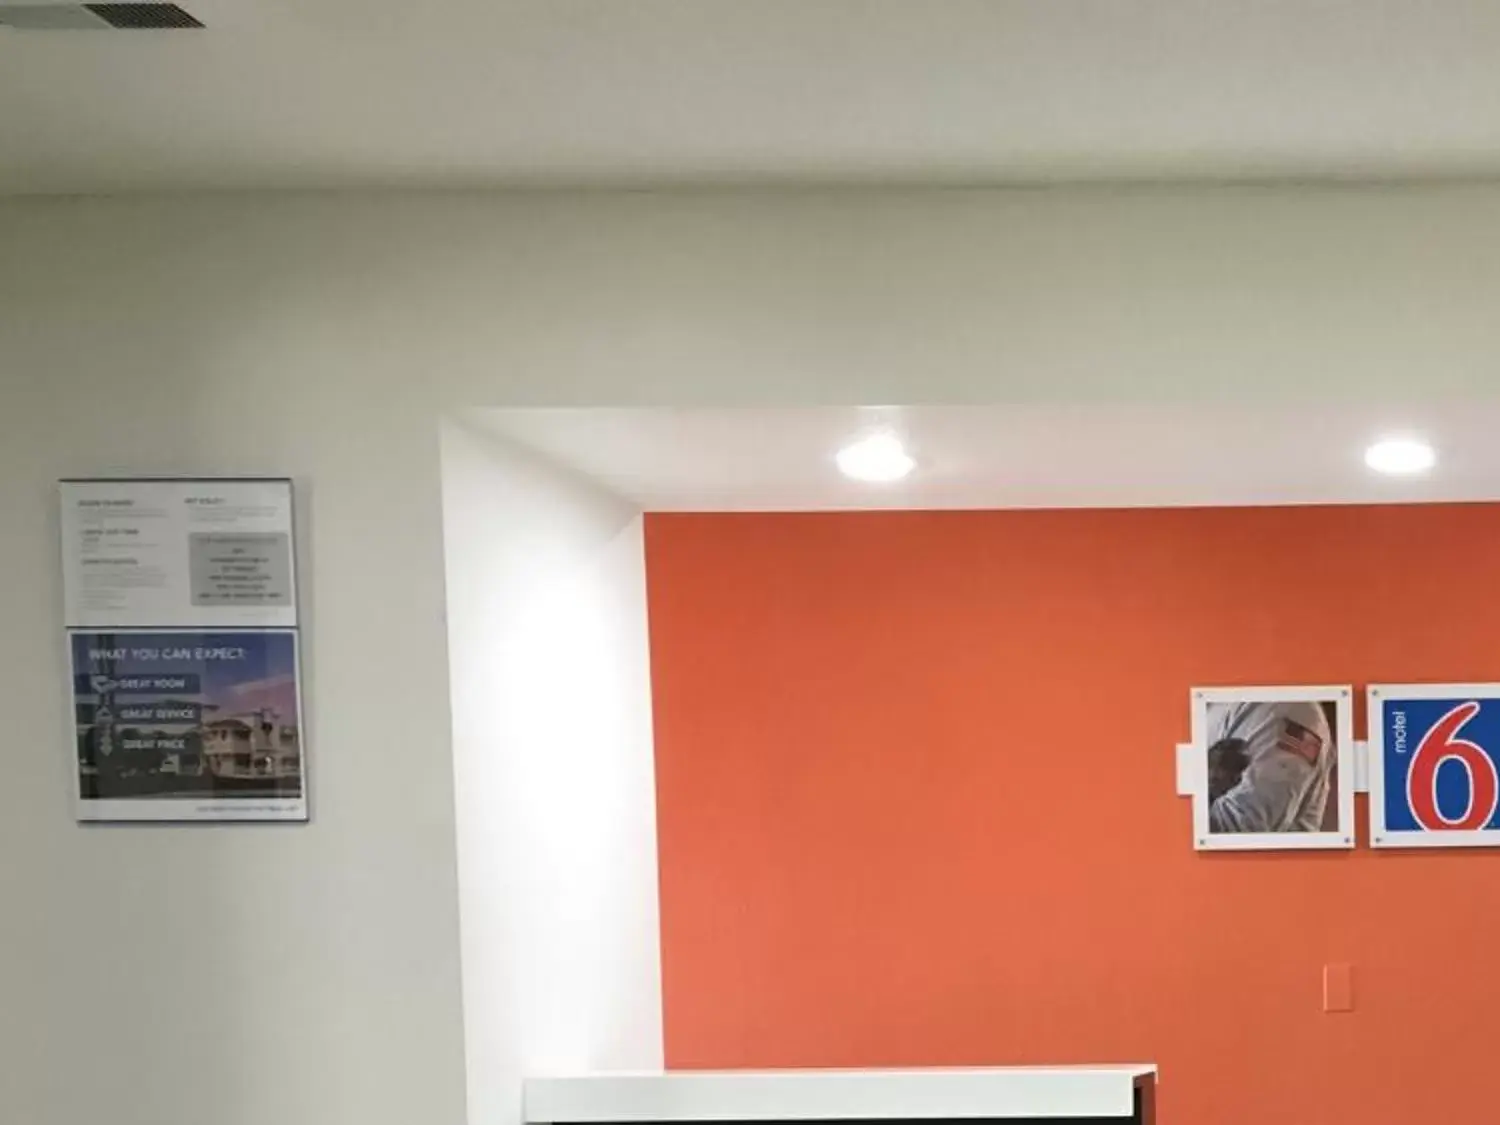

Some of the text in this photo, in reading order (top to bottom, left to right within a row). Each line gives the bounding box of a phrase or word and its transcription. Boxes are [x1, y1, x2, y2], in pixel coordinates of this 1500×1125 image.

[89, 648, 126, 661] WHAT
[132, 648, 159, 661] YOU
[161, 648, 191, 661] CAN
[1391, 711, 1407, 753] motel
[1406, 701, 1499, 832] 6
